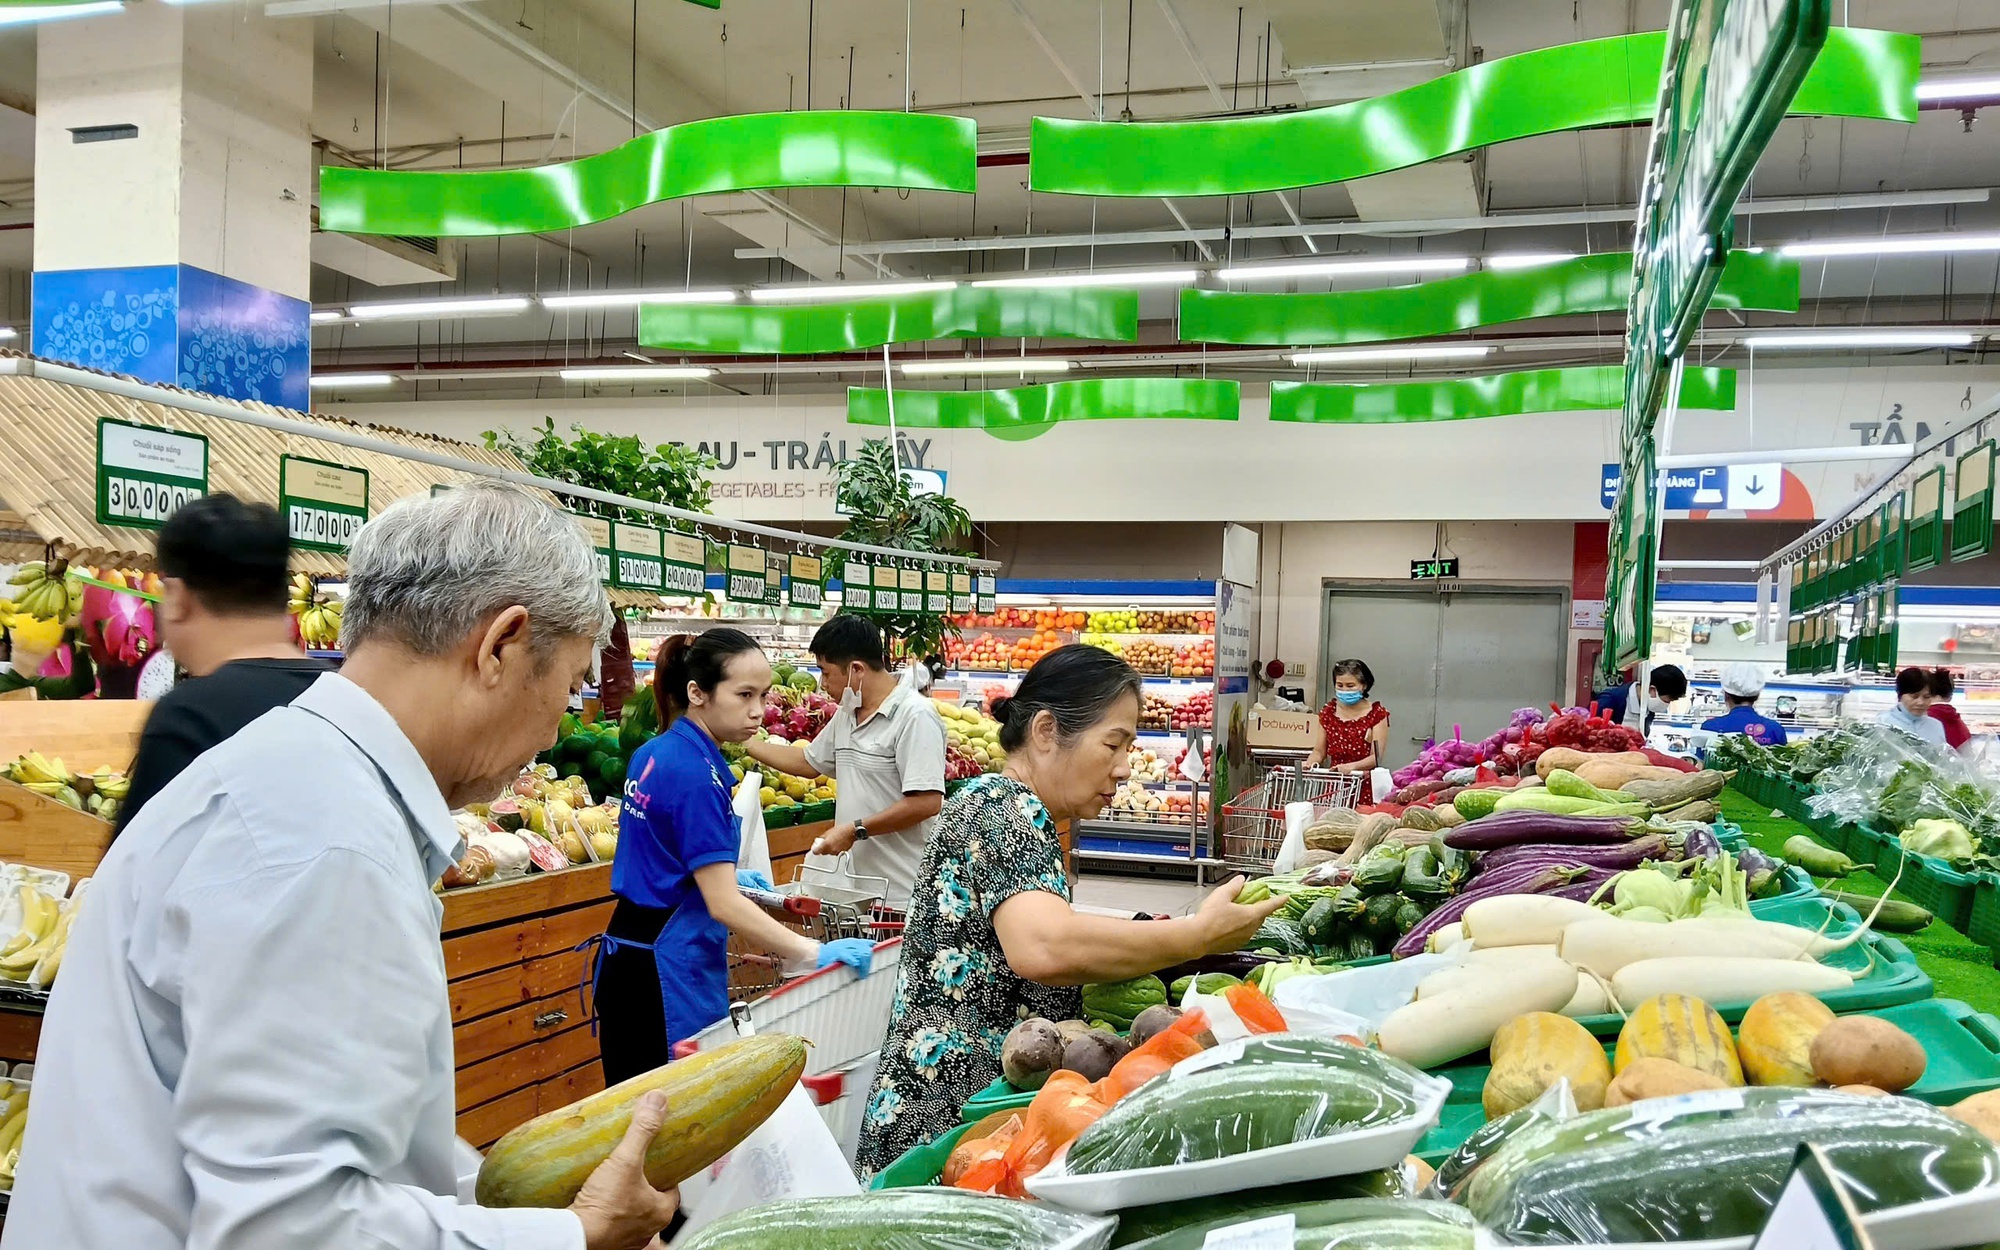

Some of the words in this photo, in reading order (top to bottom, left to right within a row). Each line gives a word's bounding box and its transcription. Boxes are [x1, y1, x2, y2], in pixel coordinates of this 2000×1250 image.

[668, 441, 738, 470] AU
[762, 431, 846, 471] TRÁI
[703, 482, 806, 499] EGETABLES
[1416, 562, 1452, 576] EXIT
